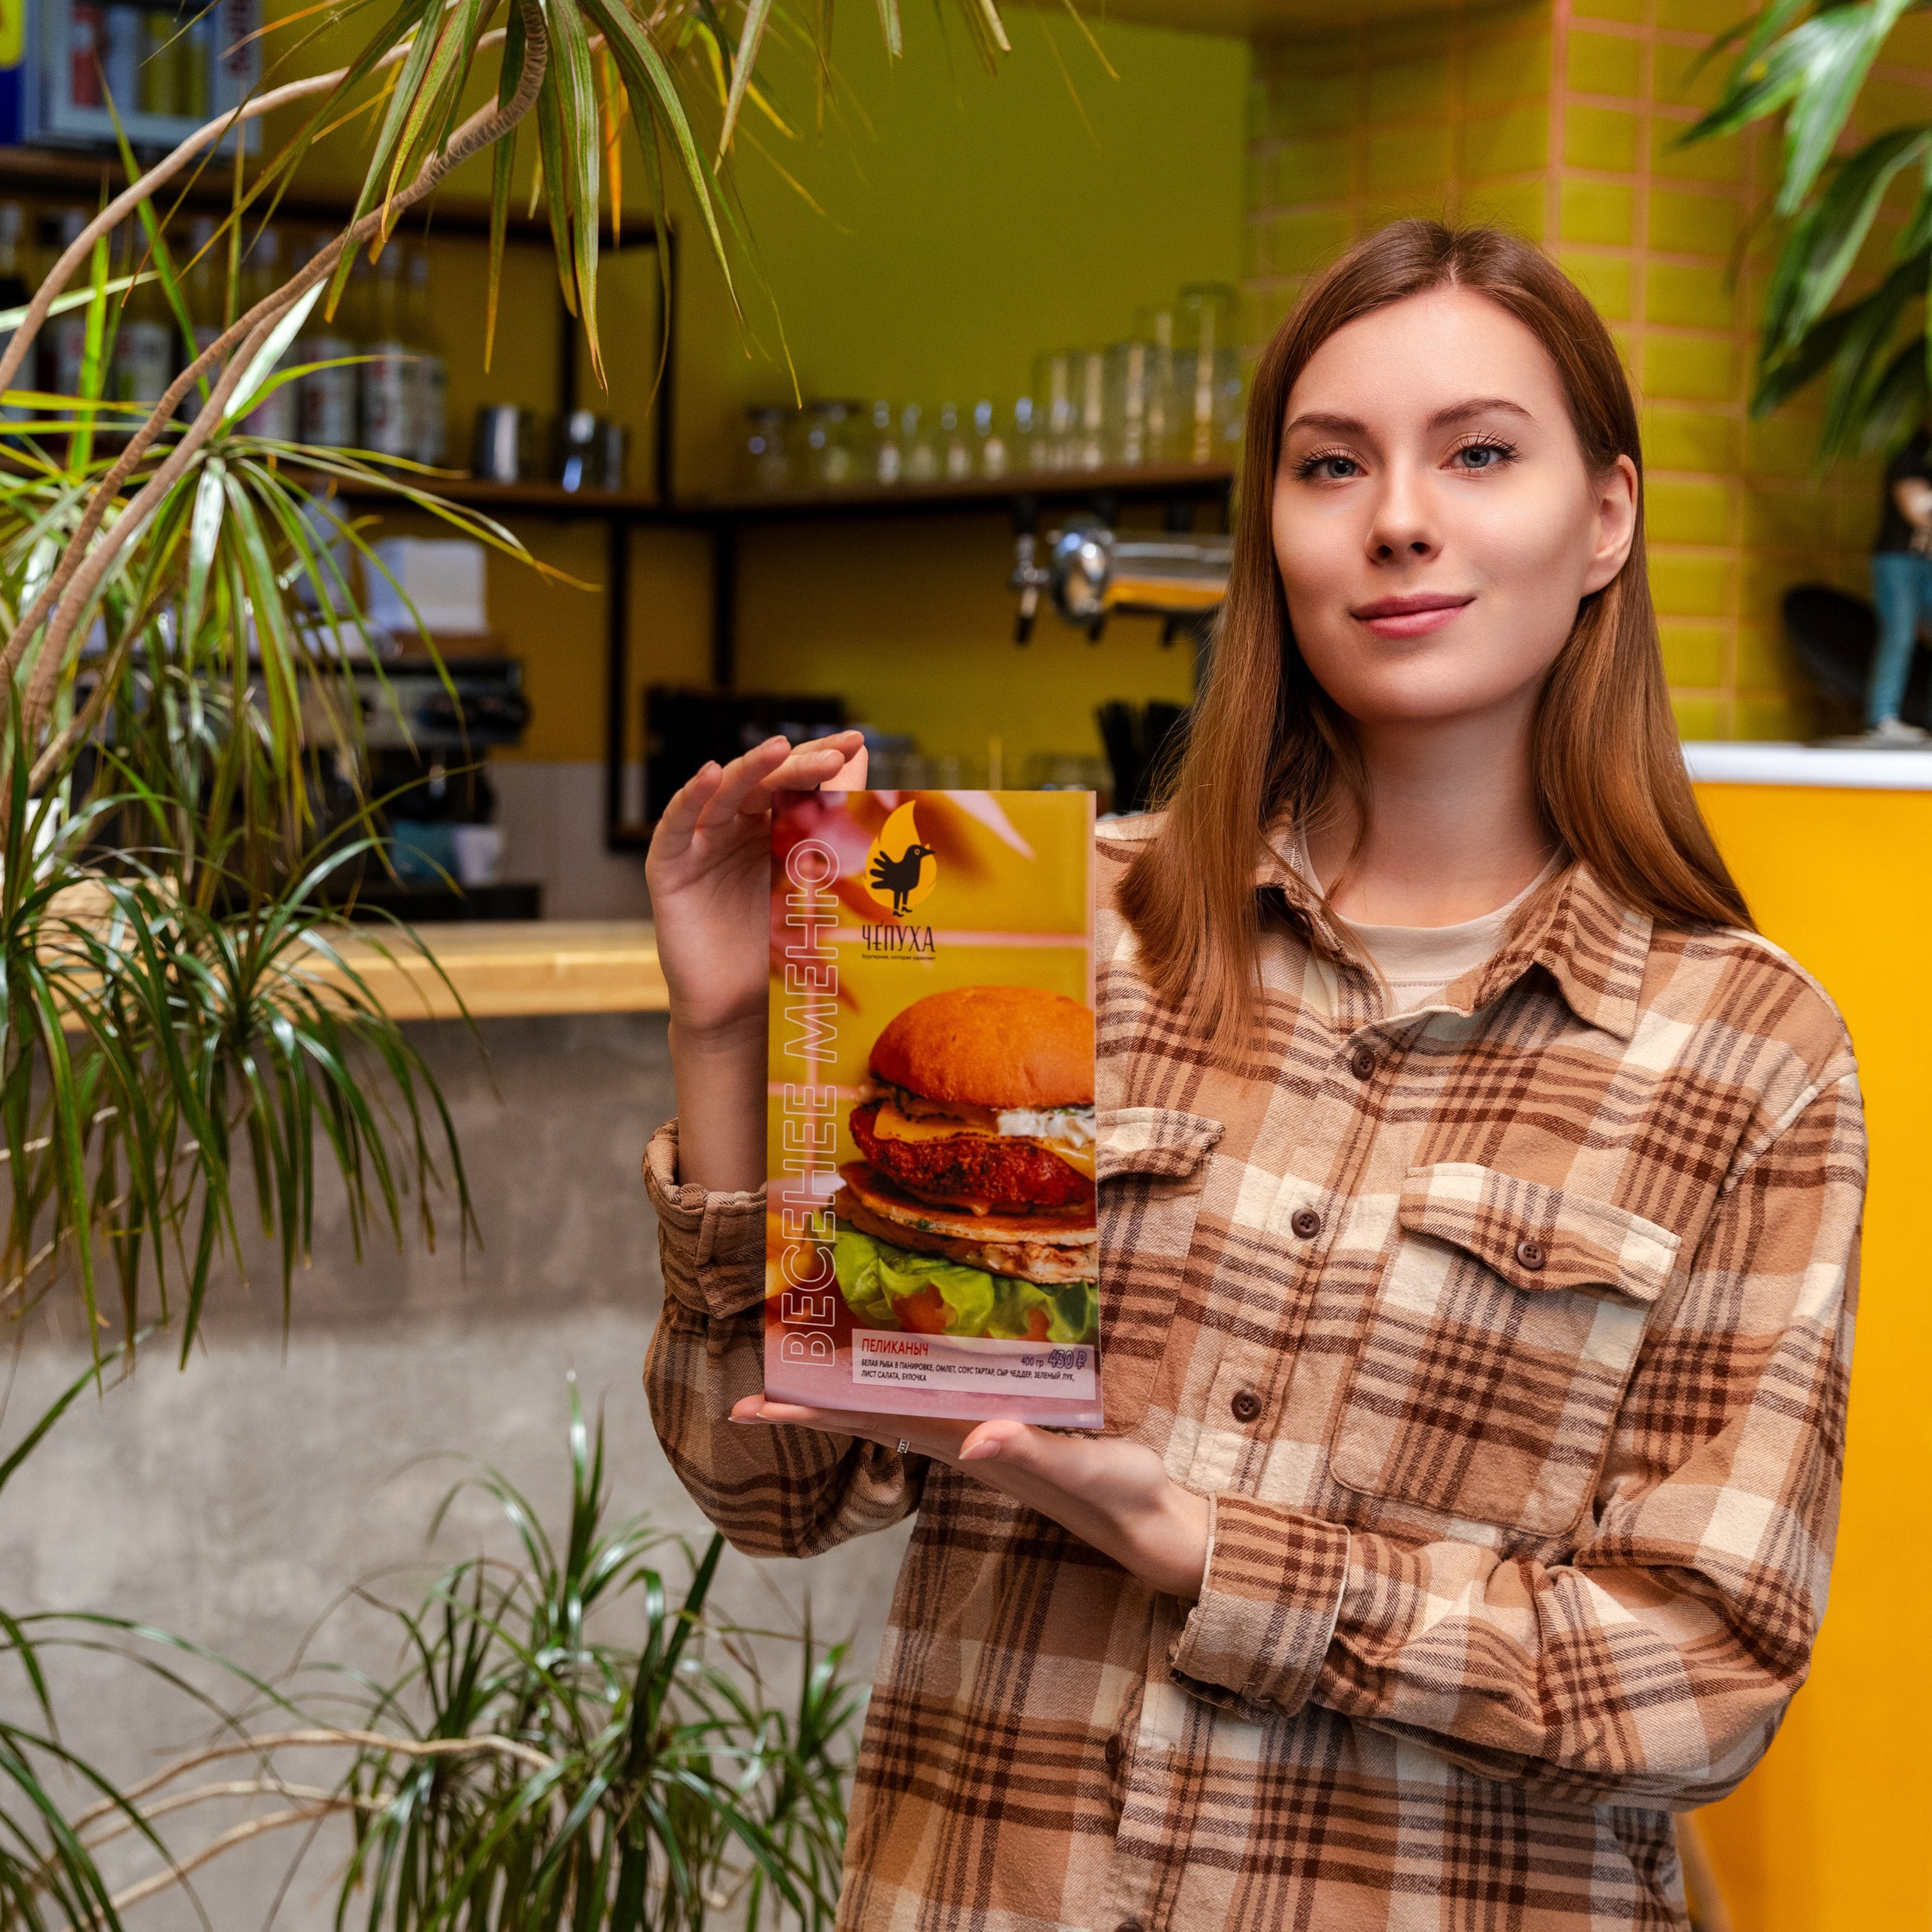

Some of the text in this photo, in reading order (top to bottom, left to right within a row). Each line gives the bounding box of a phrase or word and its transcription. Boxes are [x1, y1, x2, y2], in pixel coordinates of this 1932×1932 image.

[862, 920, 937, 952] ЧЕПУХА
[781, 838, 840, 1367] ВЕСЕНЕЕ МЕНЮ
[862, 1338, 929, 1356] ПЕЛИКАНЫЧ
[1021, 1355, 1035, 1367] 400
[1035, 1359, 1044, 1368] гр
[877, 1371, 900, 1380] САЛАТА,
[902, 1373, 927, 1382] БУЛОЧКА
[900, 1361, 934, 1372] ПАНИРОВКЕ,
[936, 1364, 956, 1374] ОМЛЕТ,
[958, 1366, 974, 1374] СОУС
[975, 1367, 995, 1376] ТАРТАР,
[1010, 1370, 1032, 1379] ЧЕДДЕР,
[1034, 1371, 1061, 1380] ЗЕЛЕНЫЙ
[1062, 1374, 1075, 1382] ЛУК,
